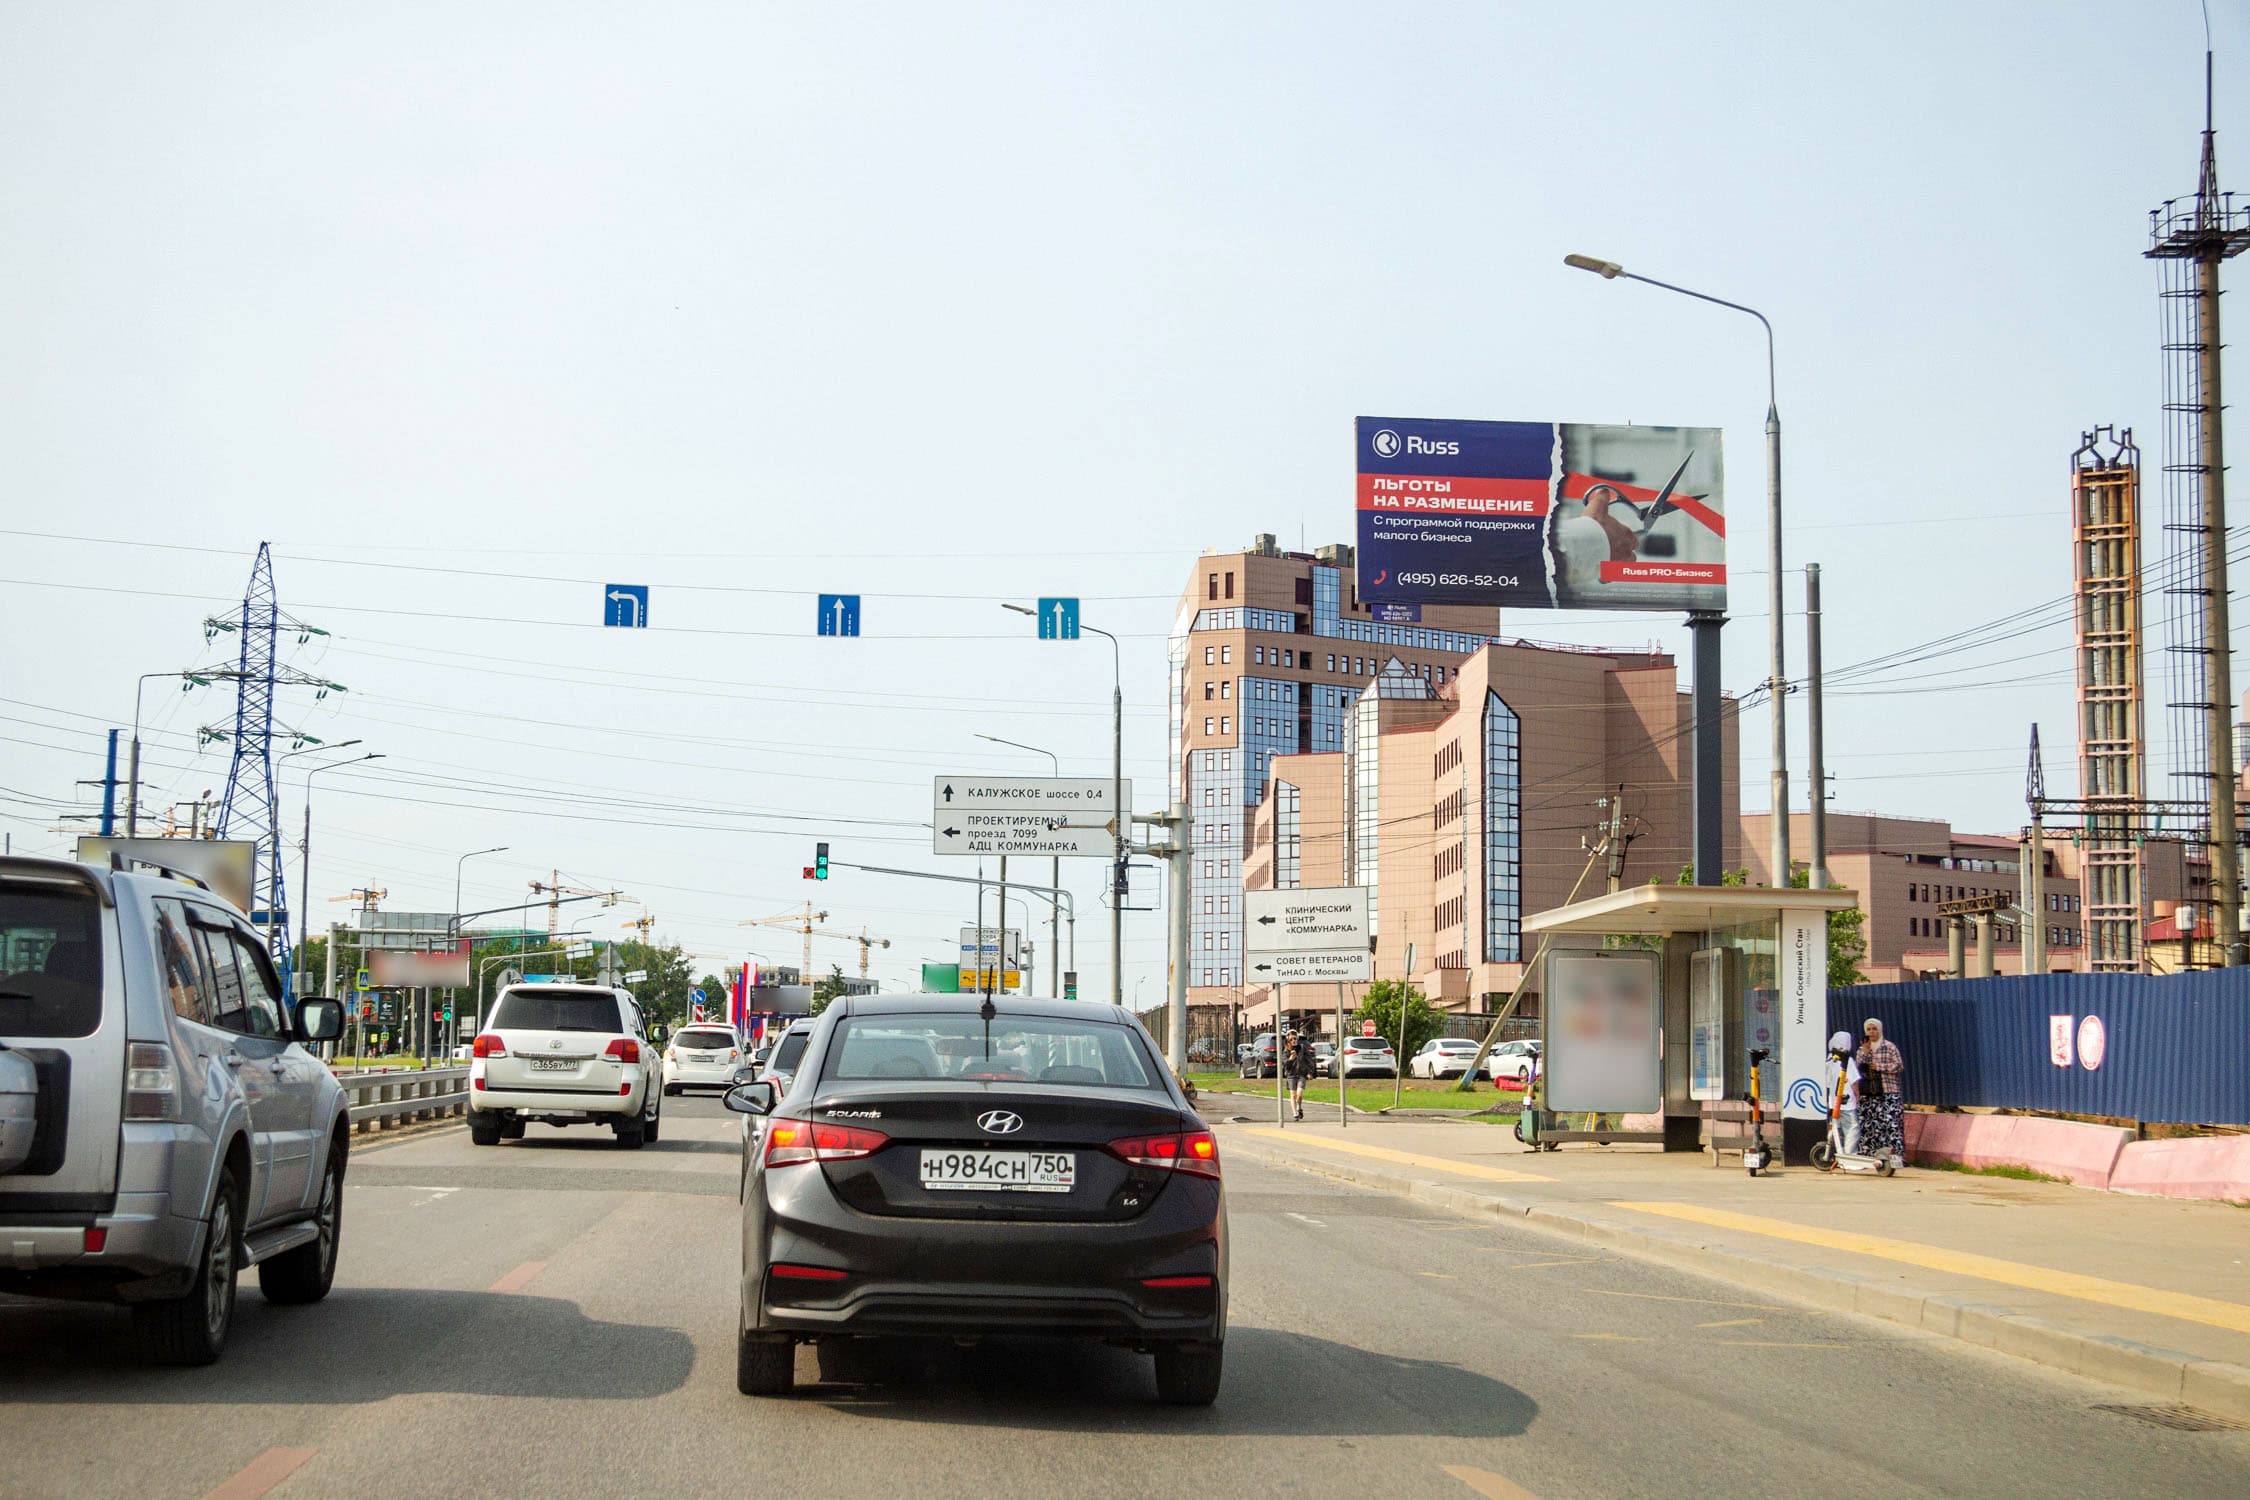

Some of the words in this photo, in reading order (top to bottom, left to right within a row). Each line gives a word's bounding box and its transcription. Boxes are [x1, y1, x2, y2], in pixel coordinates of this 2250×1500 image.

[1408, 436, 1459, 455] Russ
[1373, 478, 1451, 492] ЛЬГОТЫ
[1373, 495, 1399, 508] НА
[1404, 496, 1534, 513] РАЗМЕЩЕНИЕ
[1373, 516, 1382, 526] С
[1386, 516, 1462, 531] программой
[1465, 519, 1535, 532] поддержки
[1373, 531, 1418, 543] малого
[1421, 530, 1472, 543] бизнеса
[1622, 568, 1647, 576] Russ
[1649, 568, 1713, 578] PRO-Бизнес
[1397, 572, 1436, 587] (495)
[1439, 574, 1519, 587] 626-52-04
[968, 788, 1041, 798] КАЛУЖСКОЕ
[968, 815, 1067, 826] ПРОЕКТИРУЕМЫЙ
[968, 830, 1006, 839] проезд
[1013, 829, 1038, 838] 7099
[969, 842, 992, 851] АДЦ
[998, 842, 1078, 851] КОММУНАРКА
[1285, 904, 1352, 914] КЛИНИЧЕСКИЙ
[1286, 916, 1315, 924] ЦЕНТР
[1286, 925, 1358, 934] «КОММУНАРКА»
[1309, 956, 1362, 964] ВЕТЕРАНОВ
[1796, 950, 1804, 996] Сосенский
[1796, 999, 1804, 1024] Улица
[826, 1110, 881, 1118] SOLARIS
[929, 1154, 1025, 1179] Н984СН
[1032, 1155, 1068, 1174] 750
